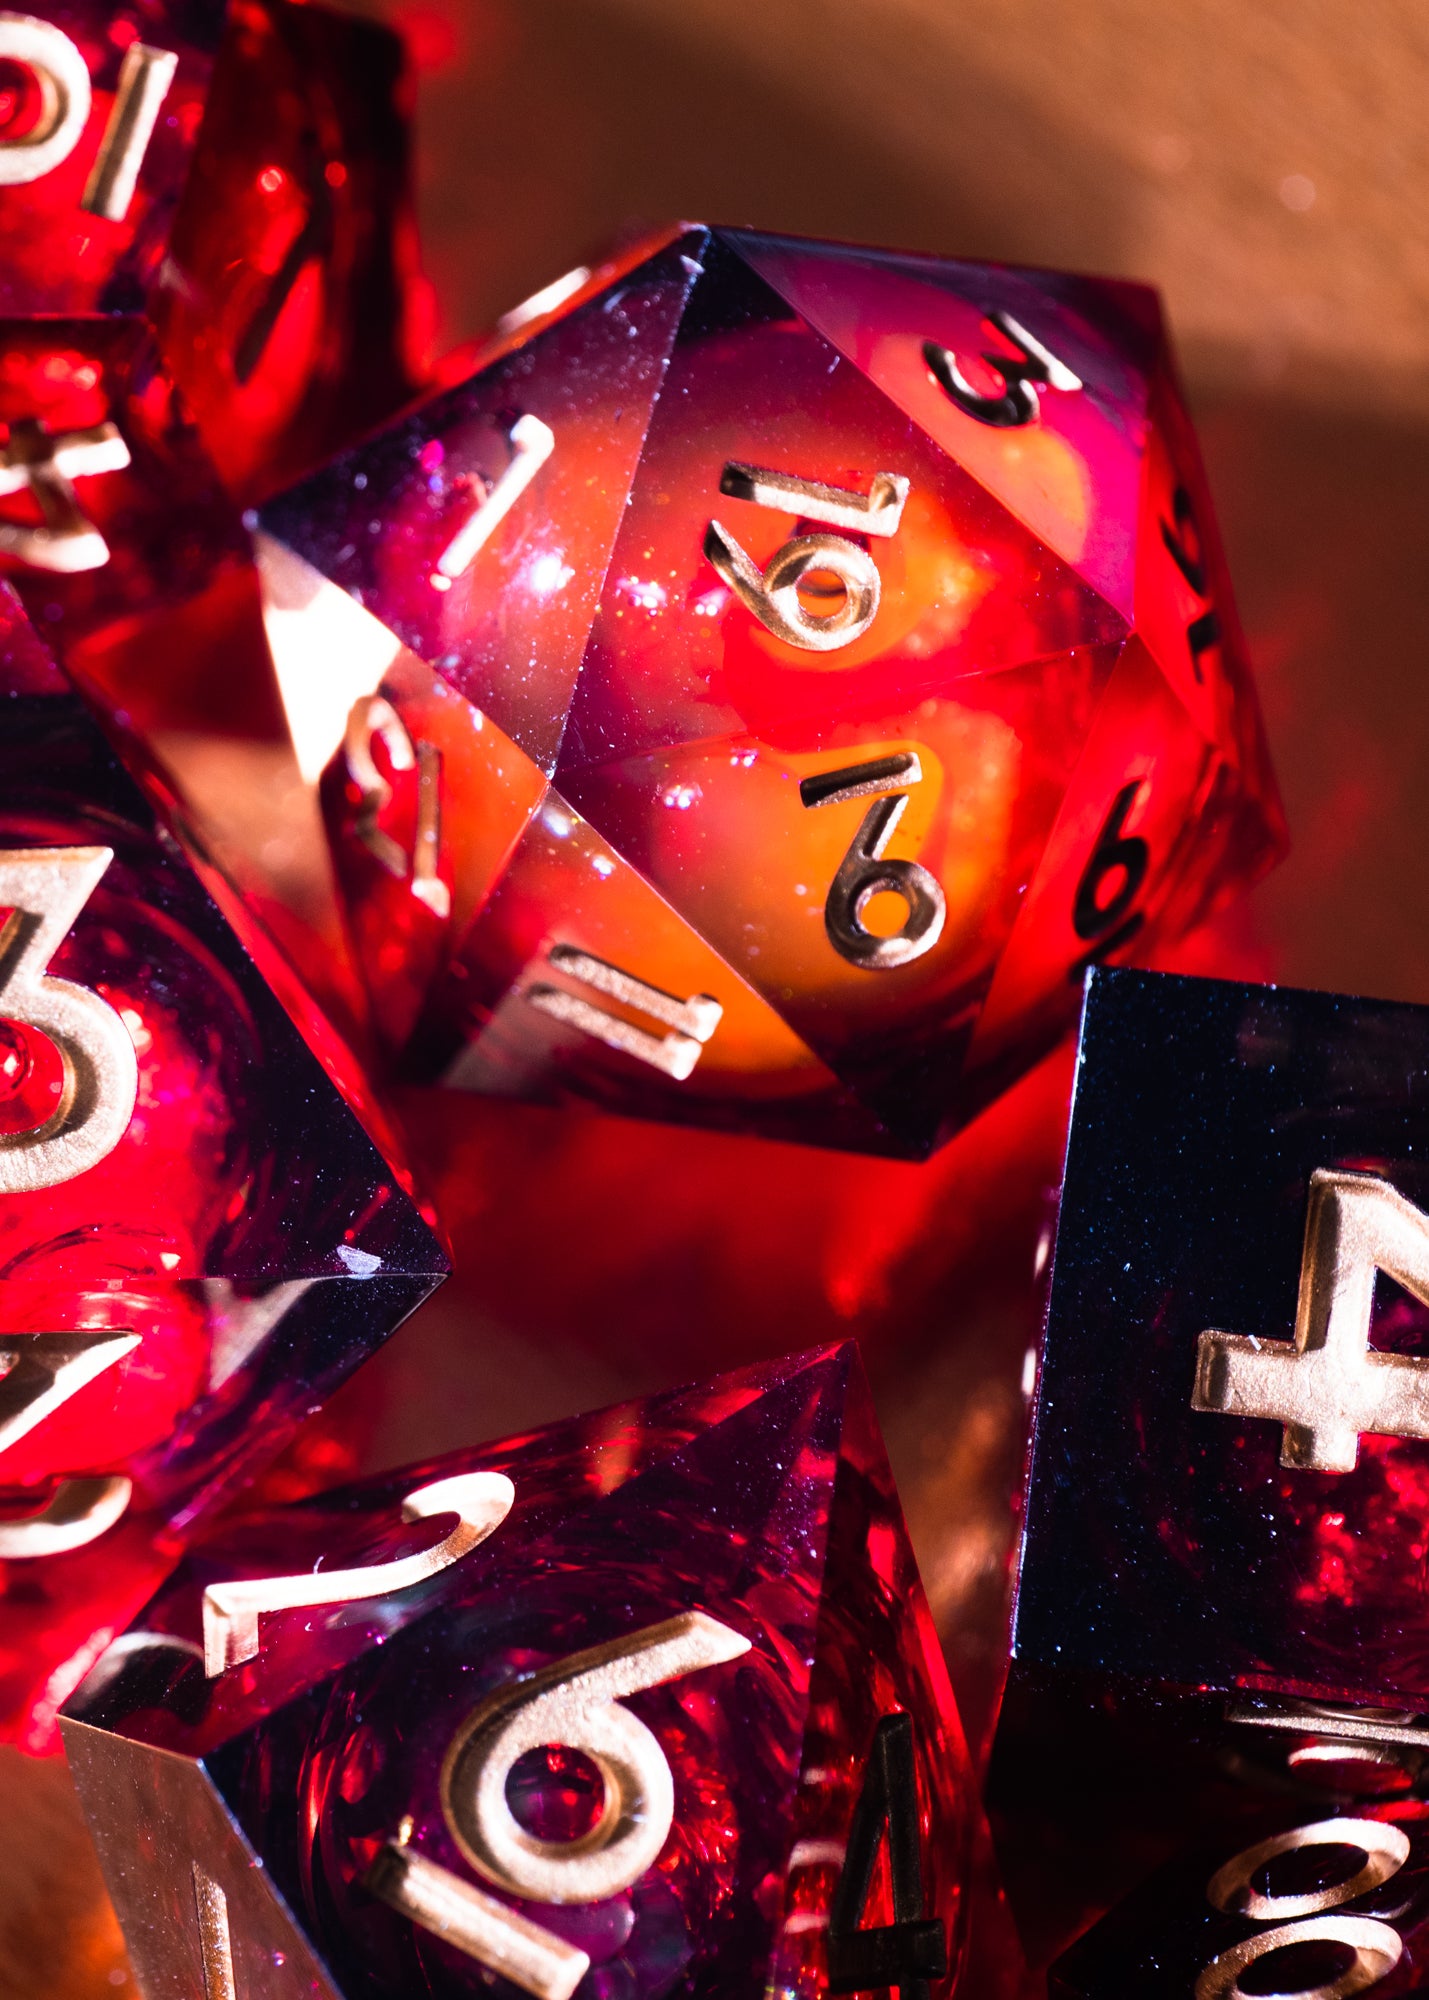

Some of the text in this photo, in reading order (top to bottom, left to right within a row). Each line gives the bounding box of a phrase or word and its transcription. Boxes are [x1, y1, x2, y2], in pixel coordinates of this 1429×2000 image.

[922, 311, 1083, 428] 3
[703, 461, 911, 652] 19
[827, 1711, 947, 2000] 4
